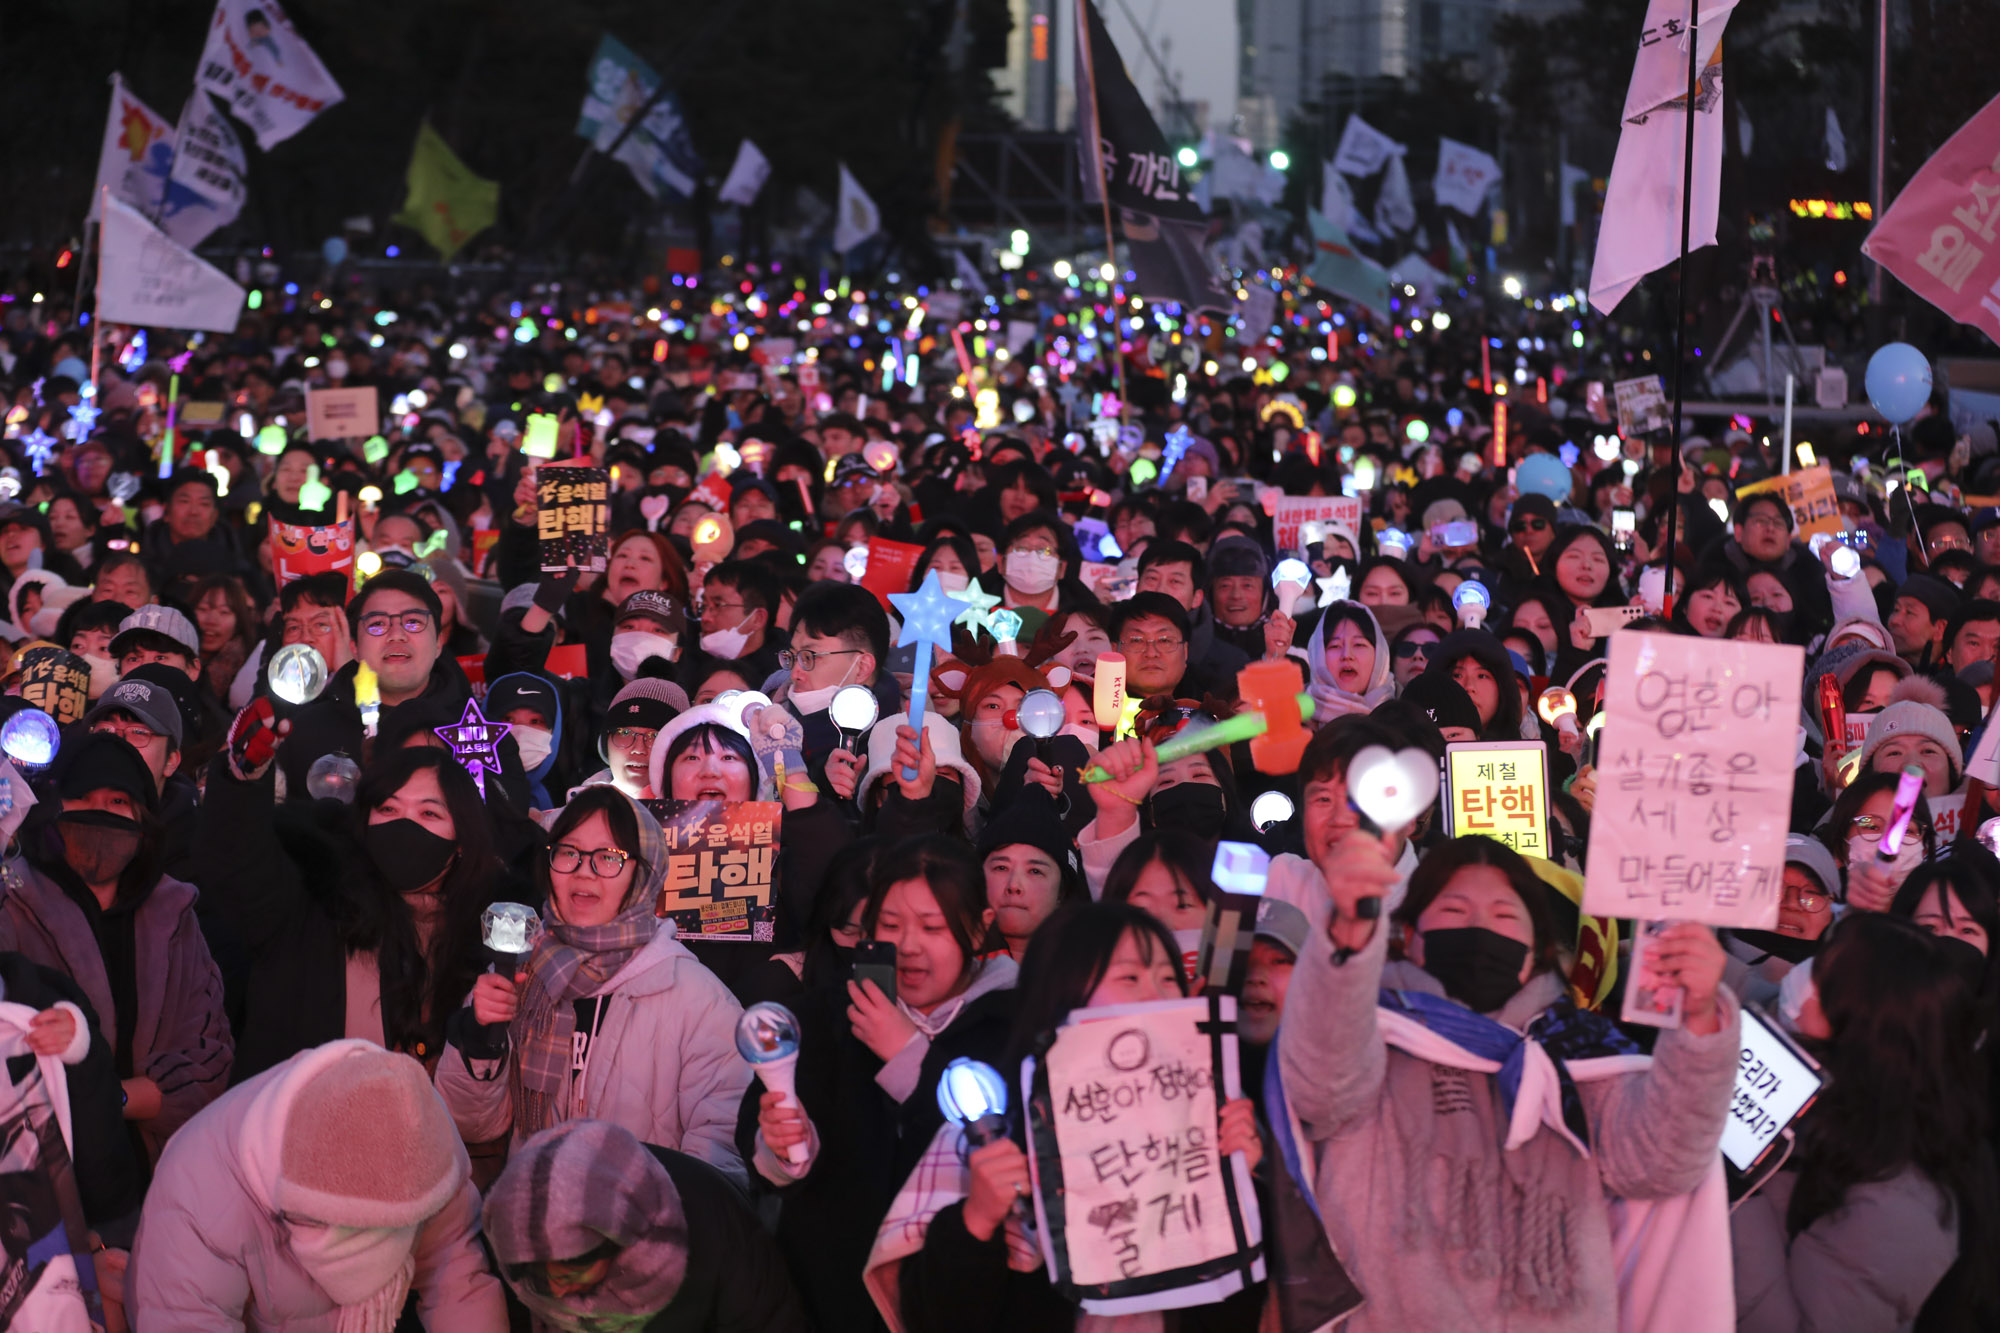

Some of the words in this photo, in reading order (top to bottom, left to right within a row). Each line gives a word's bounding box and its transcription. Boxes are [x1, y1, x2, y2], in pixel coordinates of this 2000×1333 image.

[557, 482, 607, 503] 윤석열
[538, 504, 606, 540] 탄핵!
[1477, 762, 1516, 781] 제철
[1462, 785, 1535, 828] 탄핵
[706, 820, 773, 847] 윤석열
[1502, 831, 1539, 851] 최고
[663, 847, 773, 912] 탄핵
[1089, 1126, 1210, 1189] 탄핵을
